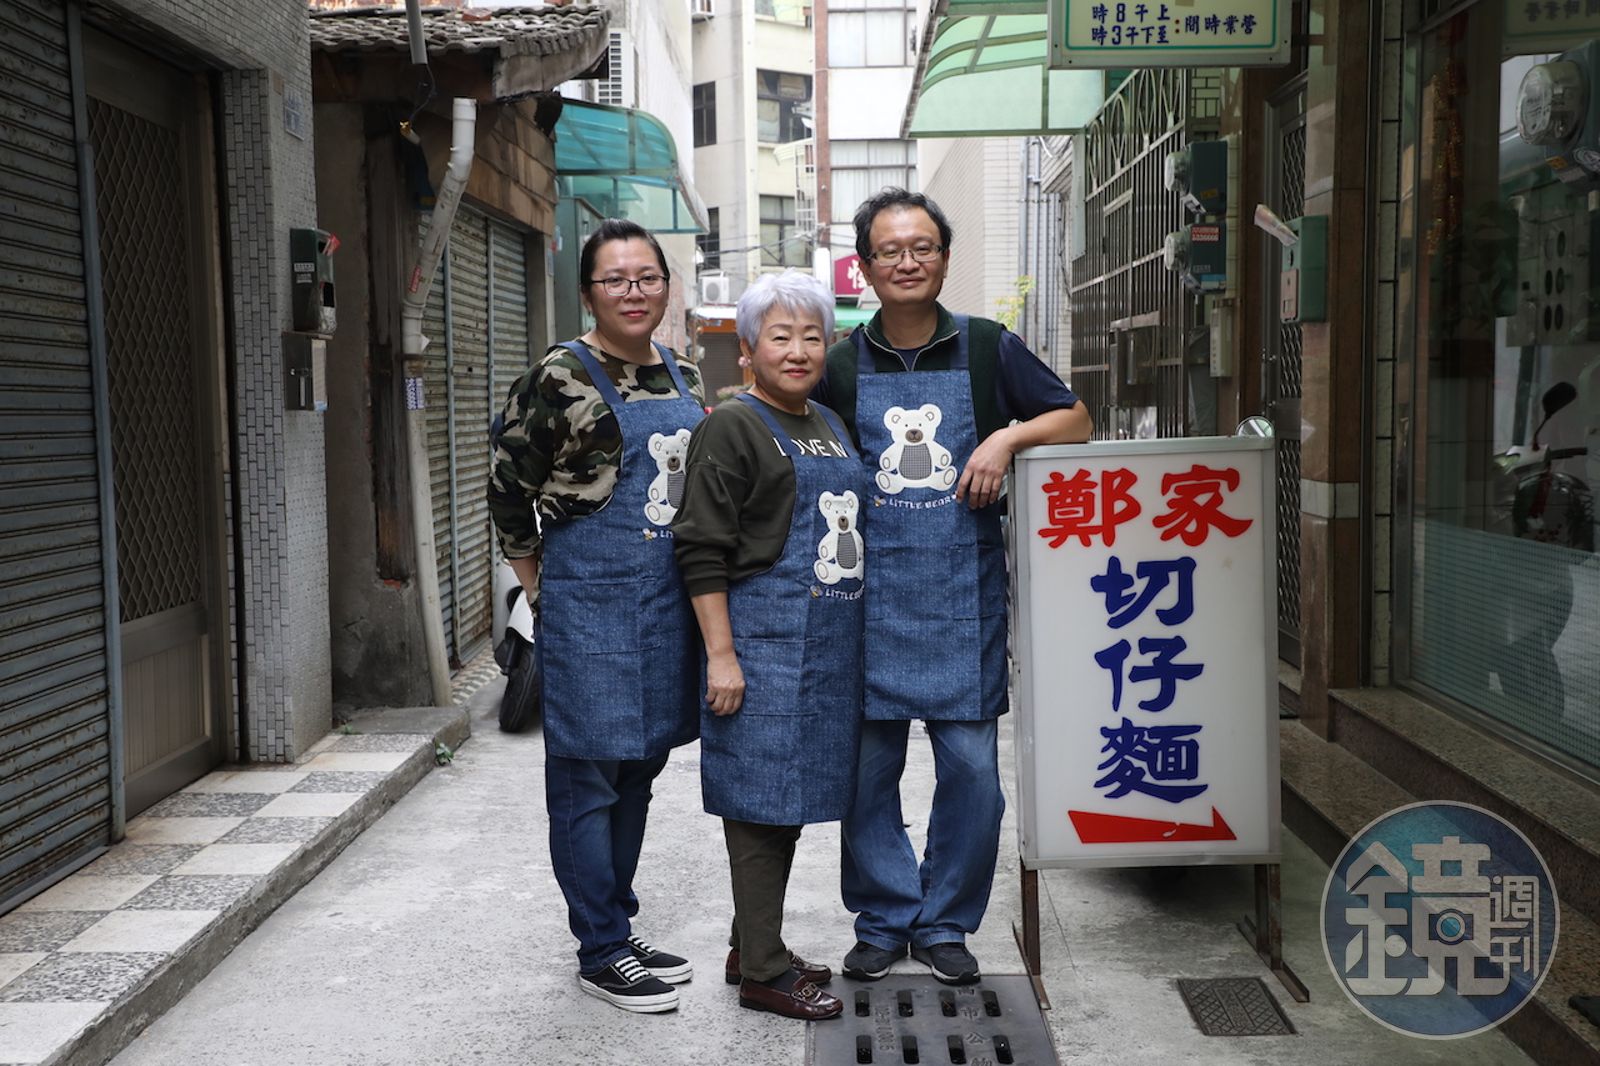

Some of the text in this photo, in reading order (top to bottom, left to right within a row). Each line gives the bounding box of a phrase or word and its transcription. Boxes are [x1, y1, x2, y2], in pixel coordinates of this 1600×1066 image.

[889, 498, 923, 510] LITTLE
[1038, 464, 1253, 548] 鄭家
[1090, 555, 1208, 803] 切仔麵
